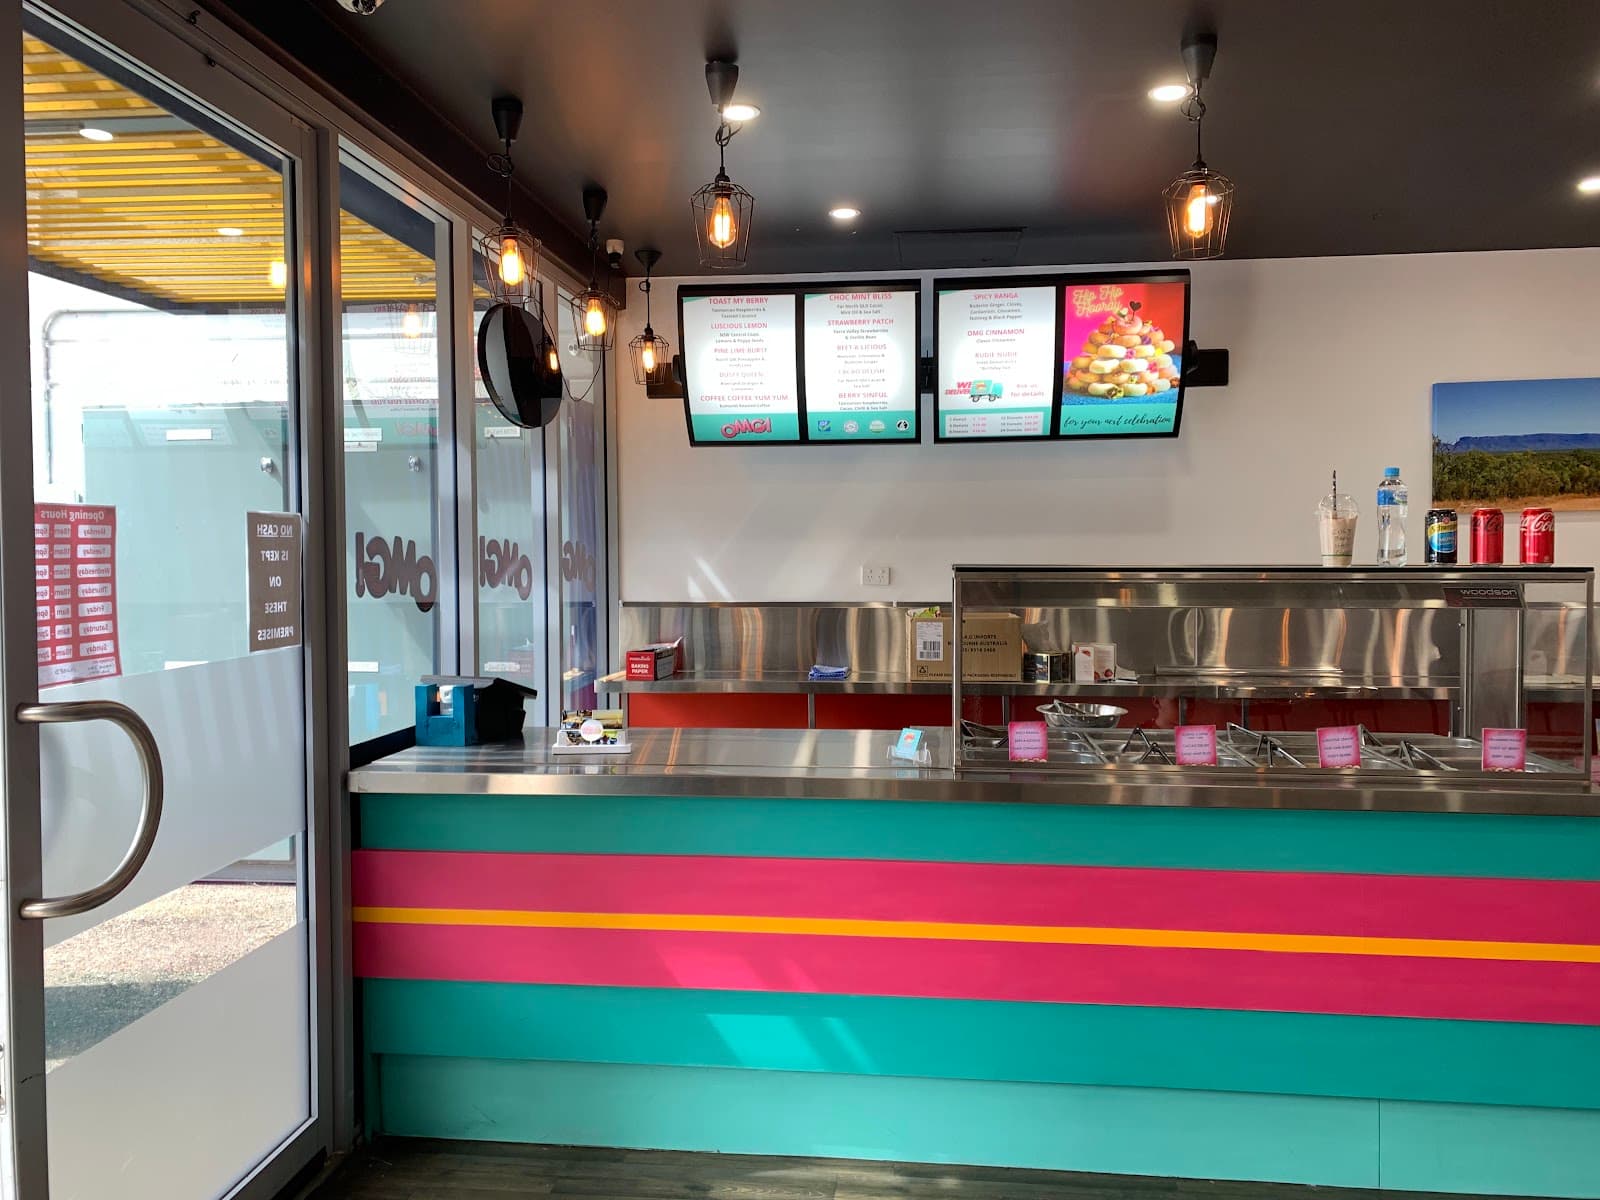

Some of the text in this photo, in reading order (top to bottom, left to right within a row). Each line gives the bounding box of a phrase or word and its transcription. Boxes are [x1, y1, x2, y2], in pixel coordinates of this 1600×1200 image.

[873, 292, 892, 300] BLISS
[721, 417, 772, 439] OMG!
[1064, 413, 1171, 429] for your next celebration
